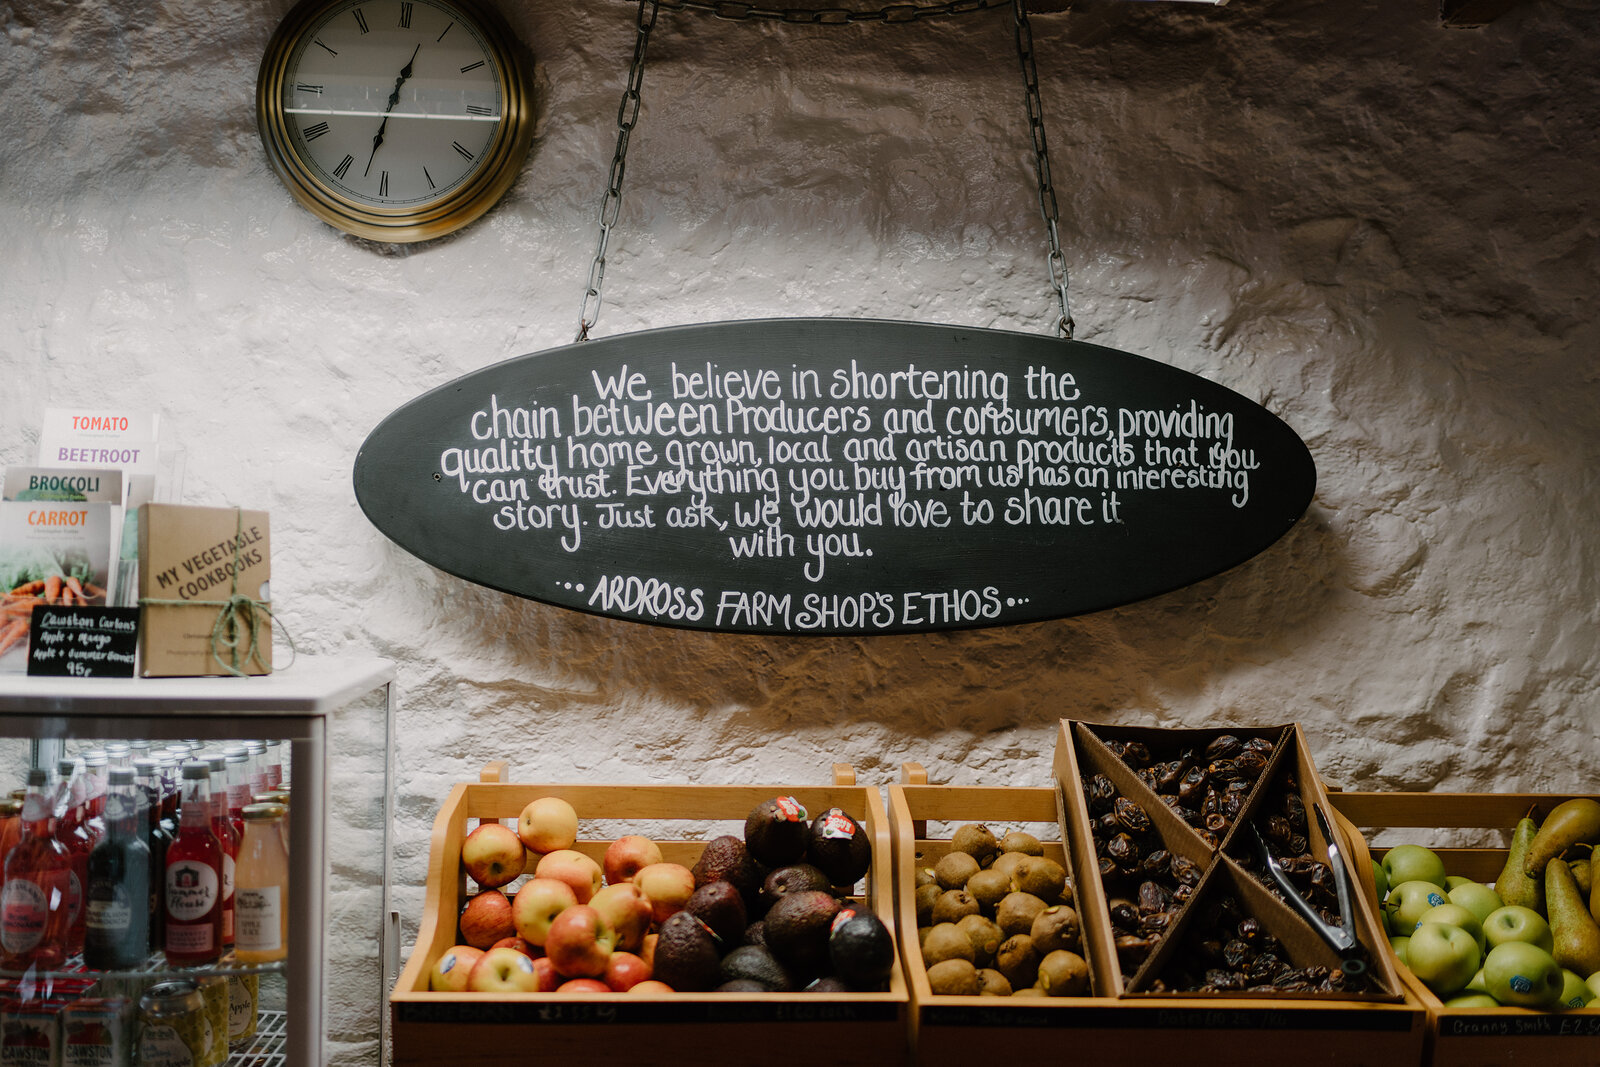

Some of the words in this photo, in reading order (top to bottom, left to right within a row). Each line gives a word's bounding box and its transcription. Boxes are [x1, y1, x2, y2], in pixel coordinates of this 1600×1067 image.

[592, 364, 652, 400] We
[671, 362, 782, 400] believe
[792, 364, 822, 399] in
[830, 359, 1009, 418] shortening
[1024, 366, 1081, 400] the
[72, 416, 128, 431] TOMATO
[471, 394, 562, 439] chain
[573, 394, 722, 436] between
[727, 398, 871, 434] Producers
[884, 399, 936, 434] and
[946, 405, 1114, 441] consumers,
[1119, 399, 1234, 460] providing
[58, 447, 140, 463] BEETROOT
[441, 438, 559, 492] quality
[567, 436, 658, 468] home
[665, 438, 762, 487] grown,
[769, 435, 832, 465] local
[843, 433, 897, 461] and
[905, 435, 1008, 462] artisan
[1017, 436, 1136, 480] products
[1145, 439, 1199, 467] that
[1209, 446, 1261, 489] you
[29, 475, 99, 492] BROCCOLI
[472, 478, 530, 503] can
[539, 469, 617, 499] trust.
[626, 461, 780, 509] Everything
[789, 468, 850, 507] you
[854, 462, 907, 509] buy
[909, 462, 983, 490] from
[988, 465, 1021, 487] us
[1028, 458, 1071, 487] has
[1075, 467, 1110, 489] an
[1117, 465, 1249, 508] interesting
[28, 510, 88, 526] CARROT
[493, 500, 588, 552] story.
[596, 503, 656, 529] Just
[666, 499, 728, 531] ask,
[735, 499, 781, 527] we
[795, 492, 882, 528] would
[893, 491, 951, 528] love
[960, 491, 994, 525] to
[1004, 488, 1095, 525] share
[1102, 490, 1122, 524] it
[156, 566, 180, 589] MY
[182, 526, 262, 574] VEGETABLE
[178, 548, 262, 600] COOKBOOKS
[729, 526, 795, 557] with
[804, 533, 873, 582] you.
[716, 591, 791, 630] FARM
[795, 592, 894, 628] SHOP'S
[1453, 1019, 1508, 1034] Granny
[1515, 1016, 1552, 1032] Smith
[1560, 1017, 1600, 1034] £2.5
